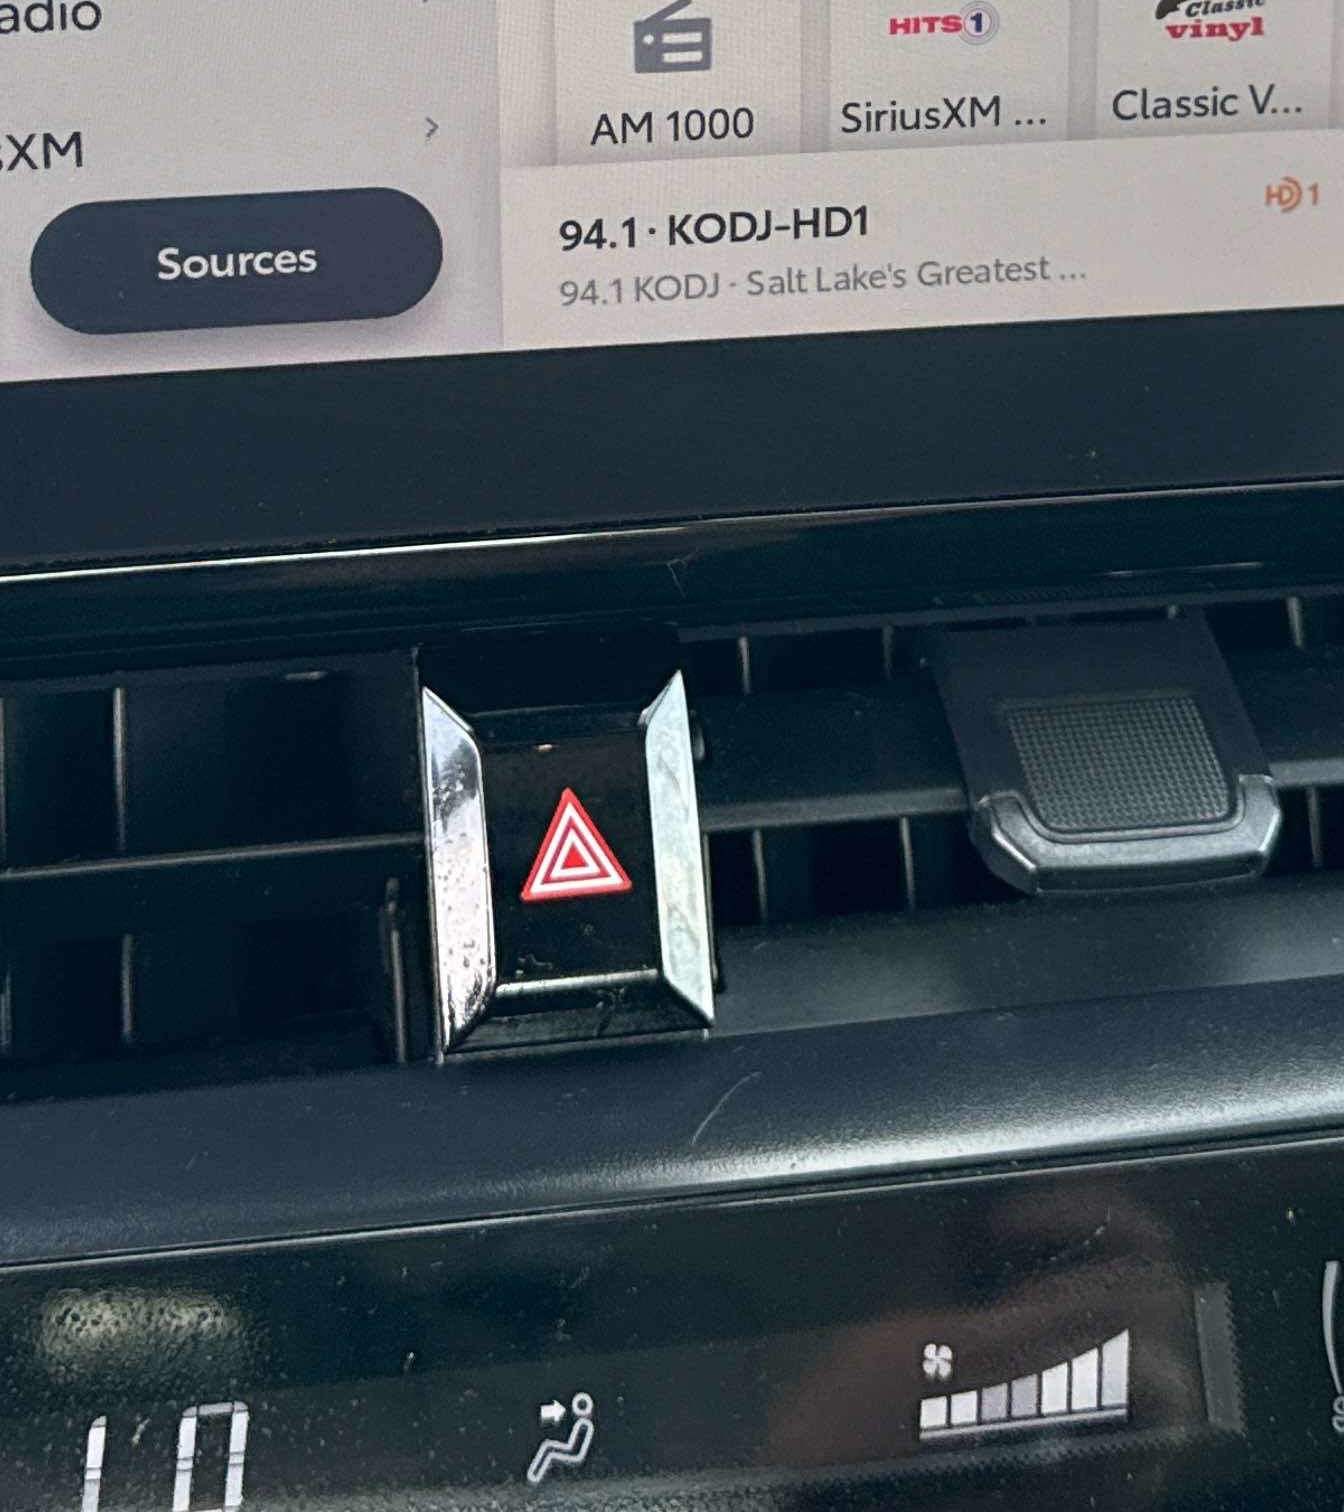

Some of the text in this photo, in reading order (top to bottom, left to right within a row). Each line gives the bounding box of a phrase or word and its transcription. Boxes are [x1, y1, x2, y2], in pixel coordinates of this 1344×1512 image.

[1165, 16, 1263, 41] vinyl
[842, 96, 1000, 133] SiriusXM
[1113, 86, 1238, 120] Classic
[591, 108, 753, 146] AM 1000
[669, 205, 866, 245] KODJ-HD1
[158, 248, 317, 280] Sources
[560, 279, 622, 306] 94.1
[635, 273, 719, 302] KODJ
[747, 267, 808, 295] Salt
[817, 263, 906, 292] Lake's
[917, 256, 1050, 286] Greatest
